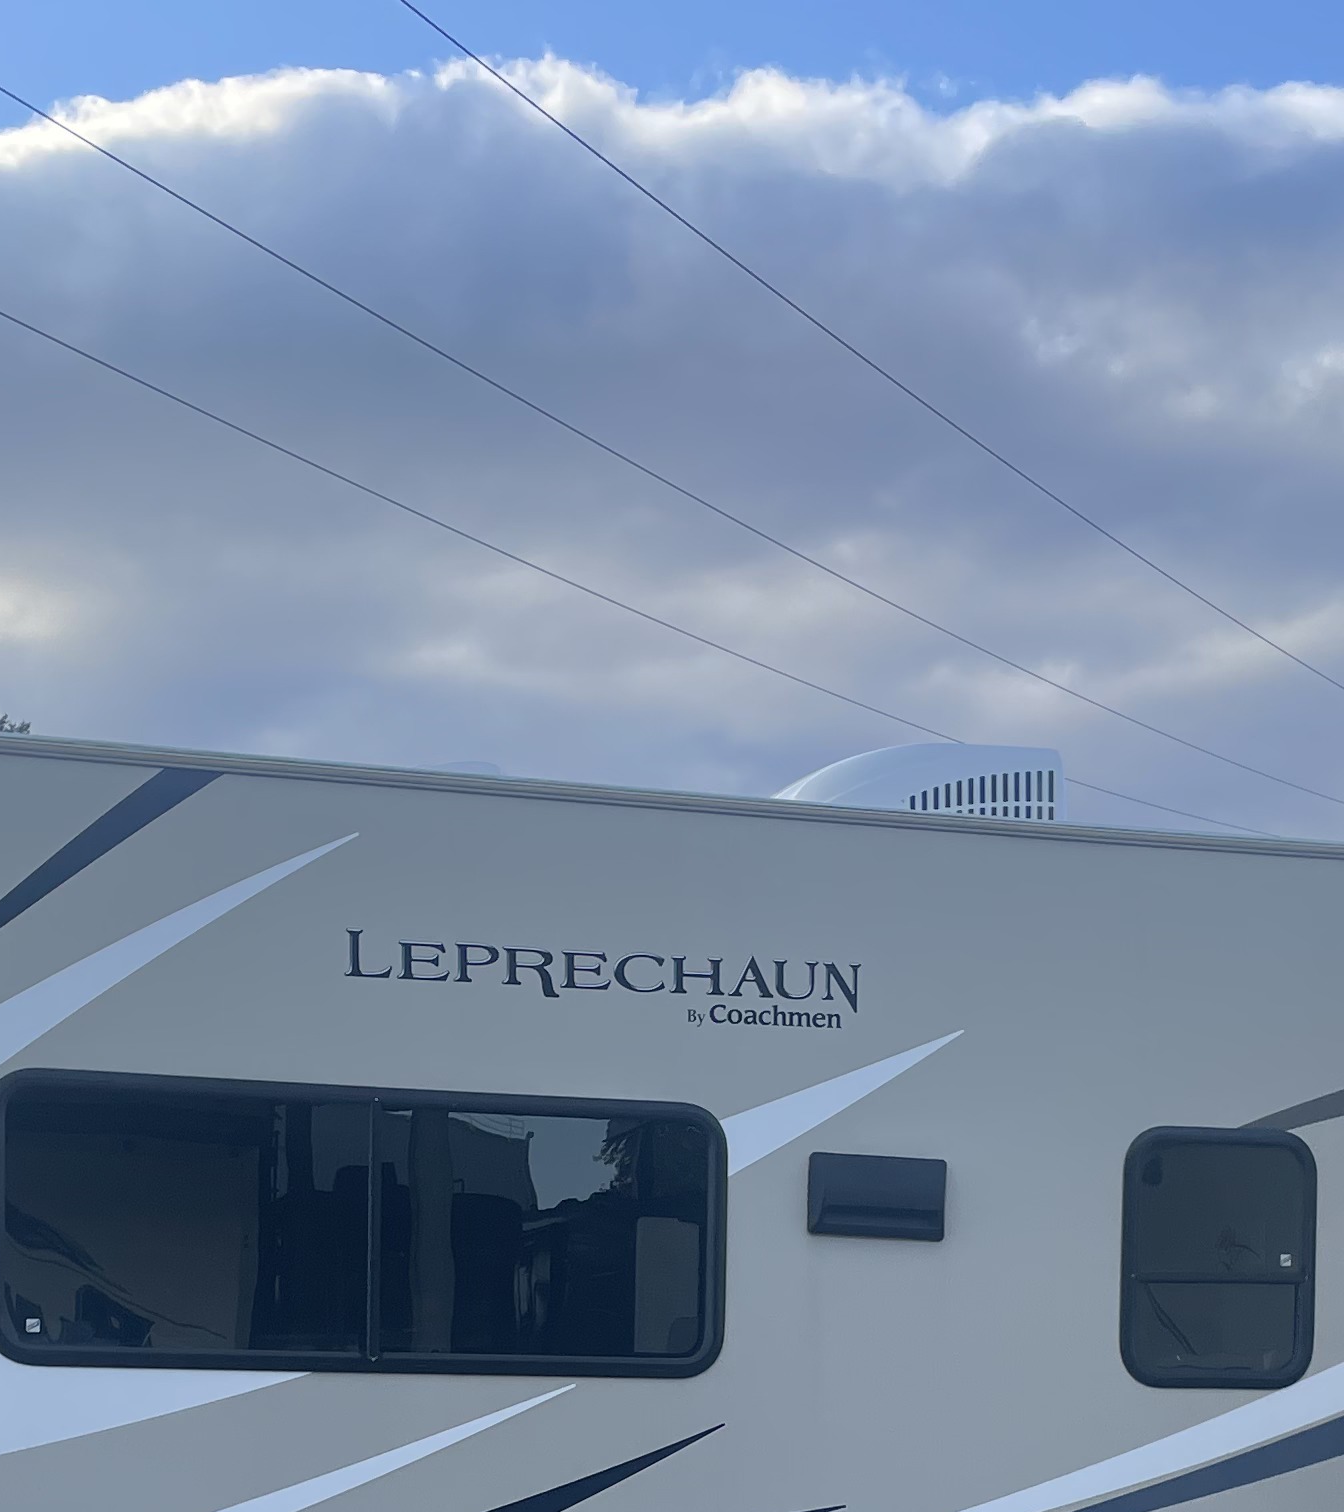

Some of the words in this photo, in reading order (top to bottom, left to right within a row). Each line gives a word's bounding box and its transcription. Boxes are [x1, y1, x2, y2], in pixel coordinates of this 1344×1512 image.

[344, 927, 862, 1013] LEPRECHAUN
[687, 1008, 706, 1028] By
[709, 1004, 842, 1029] Coachmen
